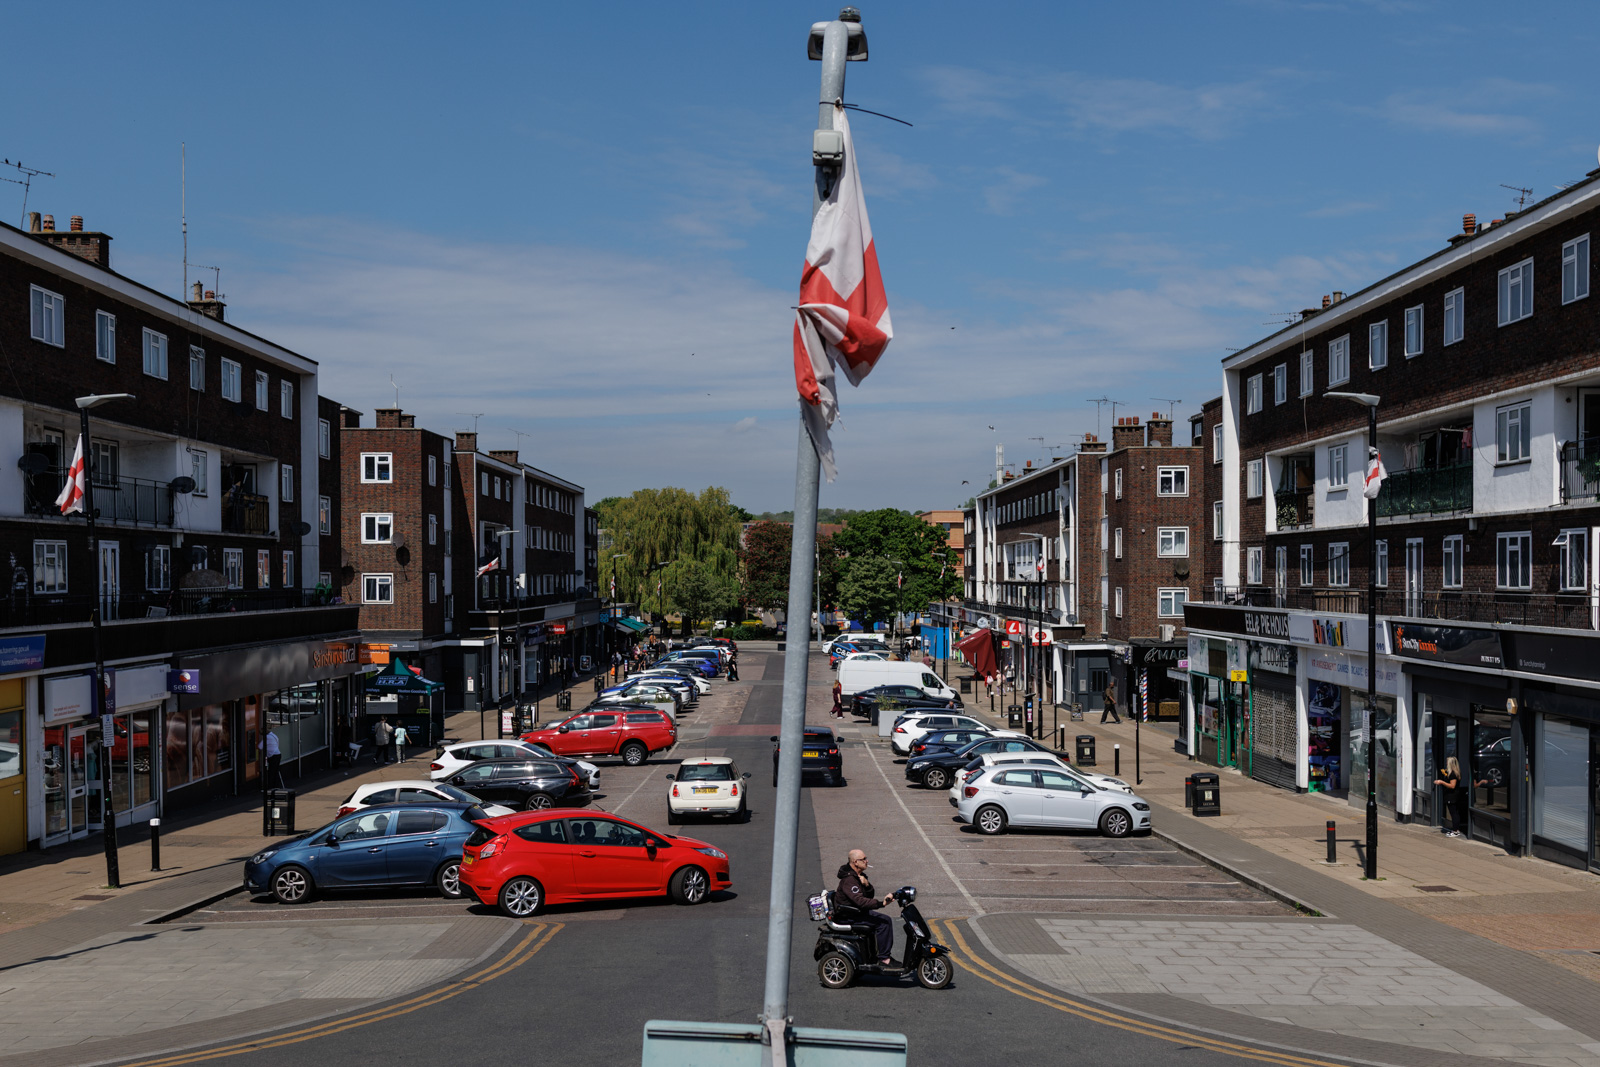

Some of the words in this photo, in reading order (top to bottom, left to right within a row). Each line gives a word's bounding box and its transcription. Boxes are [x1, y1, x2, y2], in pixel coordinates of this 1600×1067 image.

[1245, 613, 1256, 632] EEL
[1260, 614, 1270, 635] PIE
[313, 647, 343, 669] Sainsbury's
[343, 643, 356, 663] Local
